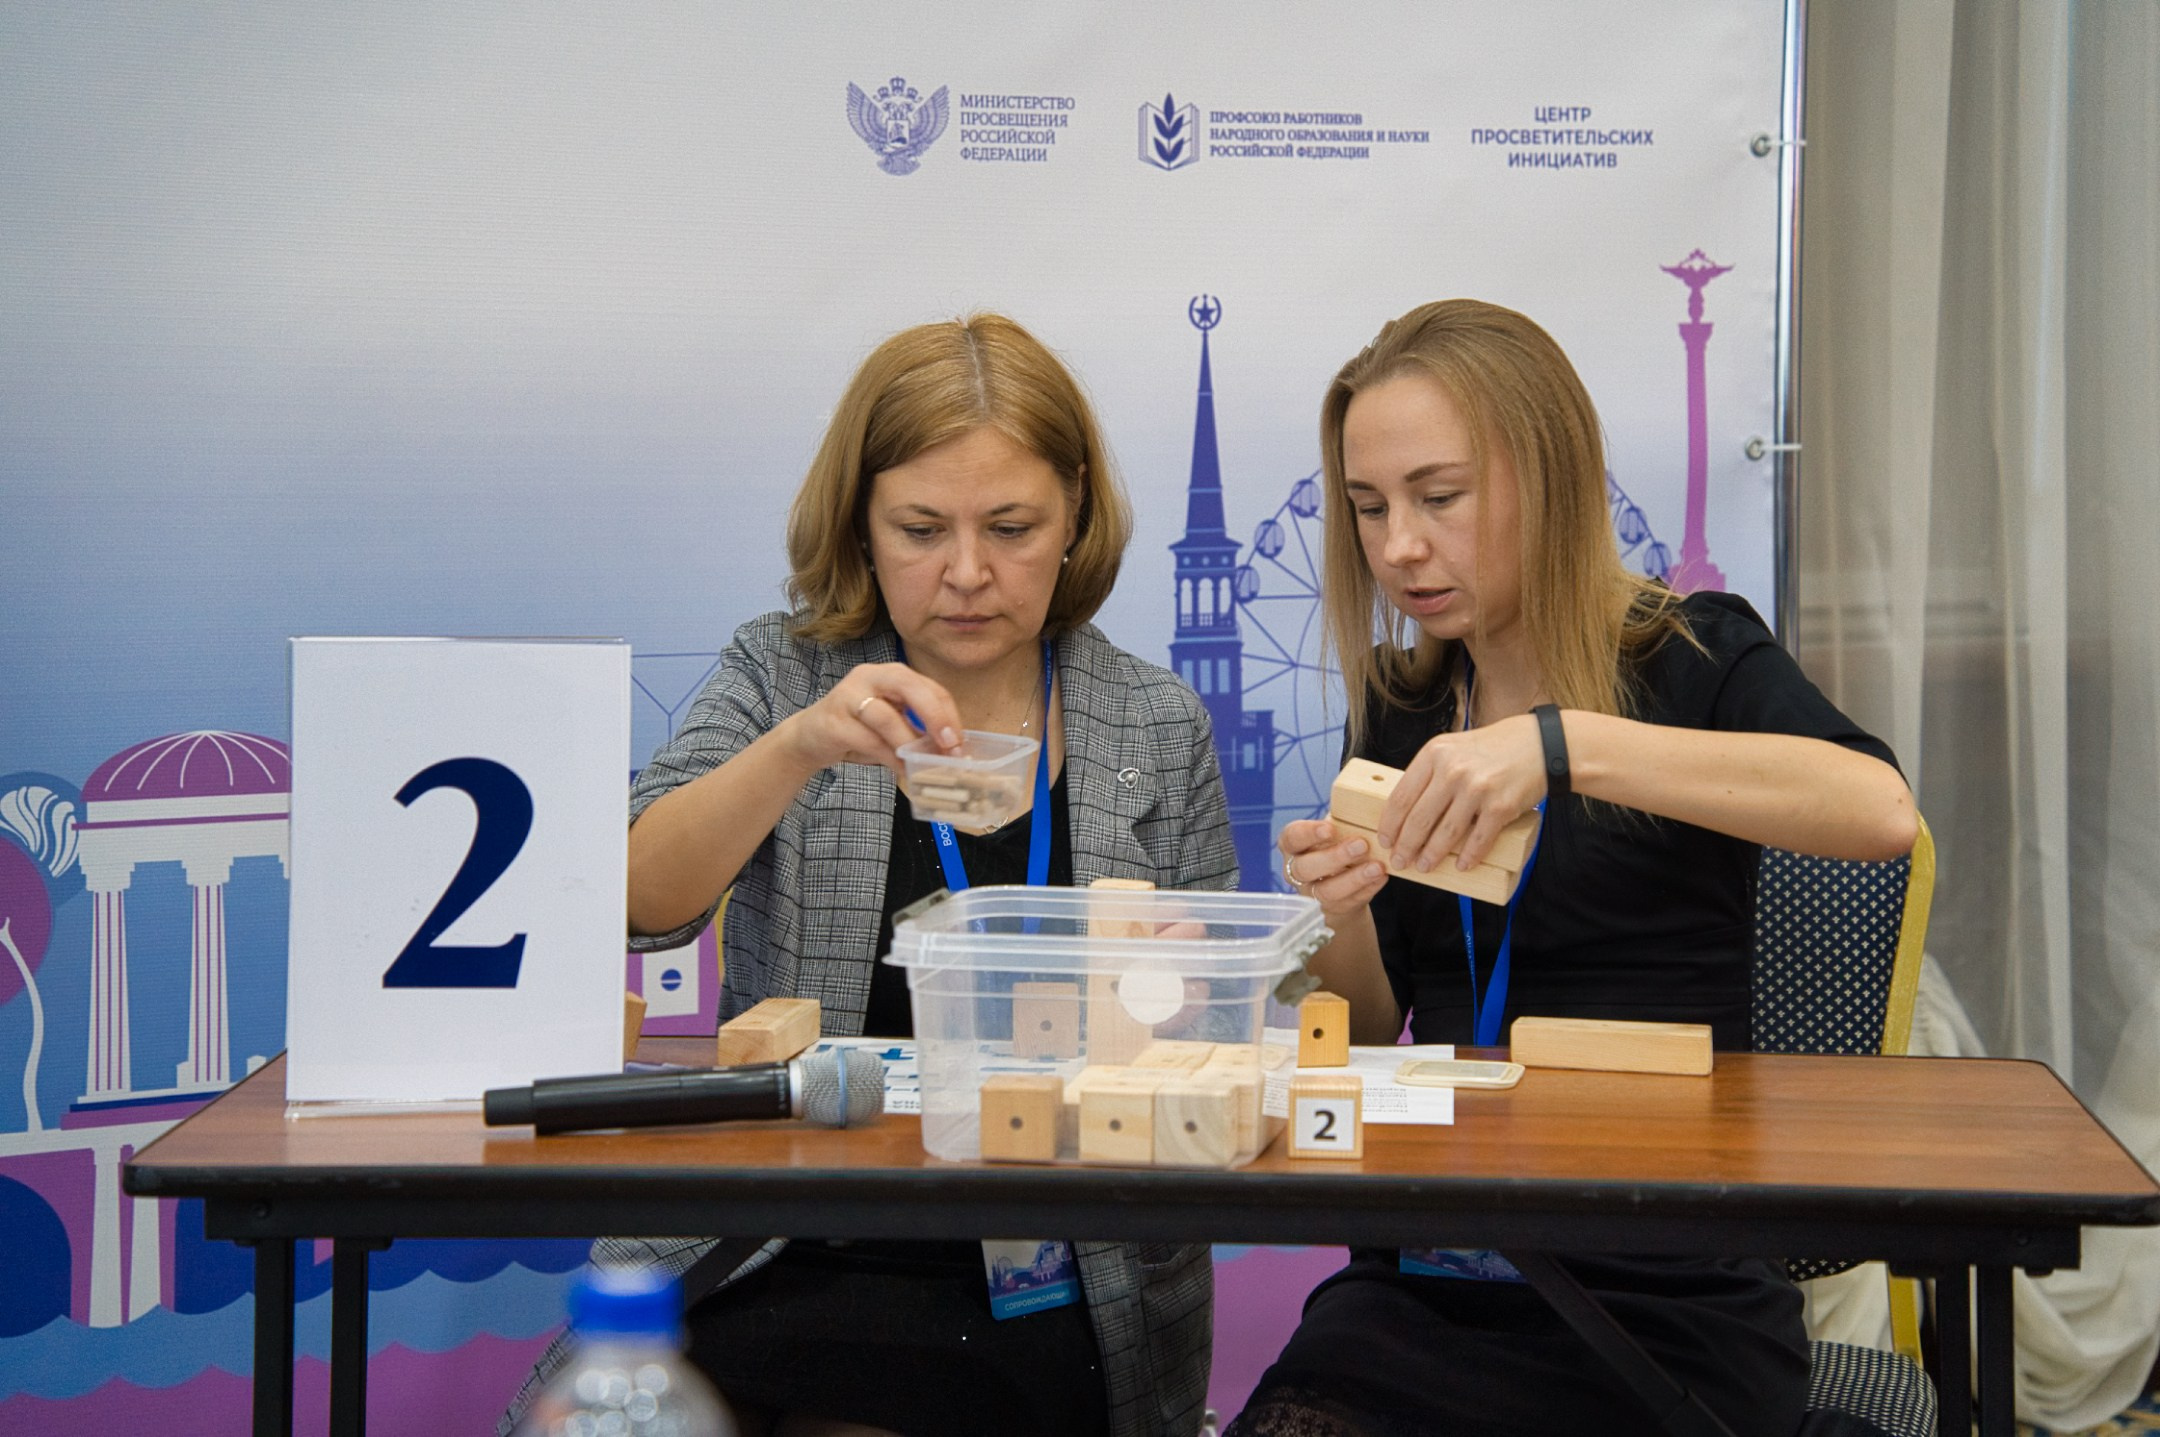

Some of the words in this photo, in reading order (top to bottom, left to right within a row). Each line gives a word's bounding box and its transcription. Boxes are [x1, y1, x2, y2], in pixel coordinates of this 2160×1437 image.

[960, 94, 1076, 110] МИНИСТЕРСТВО
[960, 111, 1068, 128] ПРОСВЕЩЕНИЯ
[1210, 111, 1281, 124] ПРОФСОЮЗ
[1283, 112, 1363, 126] РАБОТНИКОВ
[1534, 106, 1592, 124] ЦЕНТР
[960, 128, 1056, 145] РОССИЙСКОЙ
[1210, 128, 1285, 142] НАРОДНОГО
[1287, 129, 1374, 142] ОБРАЗОВАНИЯ
[1376, 131, 1386, 143] И
[1388, 131, 1430, 143] НАУКИ
[1471, 128, 1654, 146] ПРОСВЕТИТЕЛЬСКИХ
[960, 147, 1048, 162] ФЕДЕРАЦИИ
[1210, 143, 1294, 158] РОССИЙСКОЙ
[1296, 146, 1370, 160] ФЕДЕРАЦИИ
[1508, 152, 1618, 170] ИНИЦИАТИВ
[383, 756, 534, 989] 2
[1313, 1110, 1337, 1141] 2
